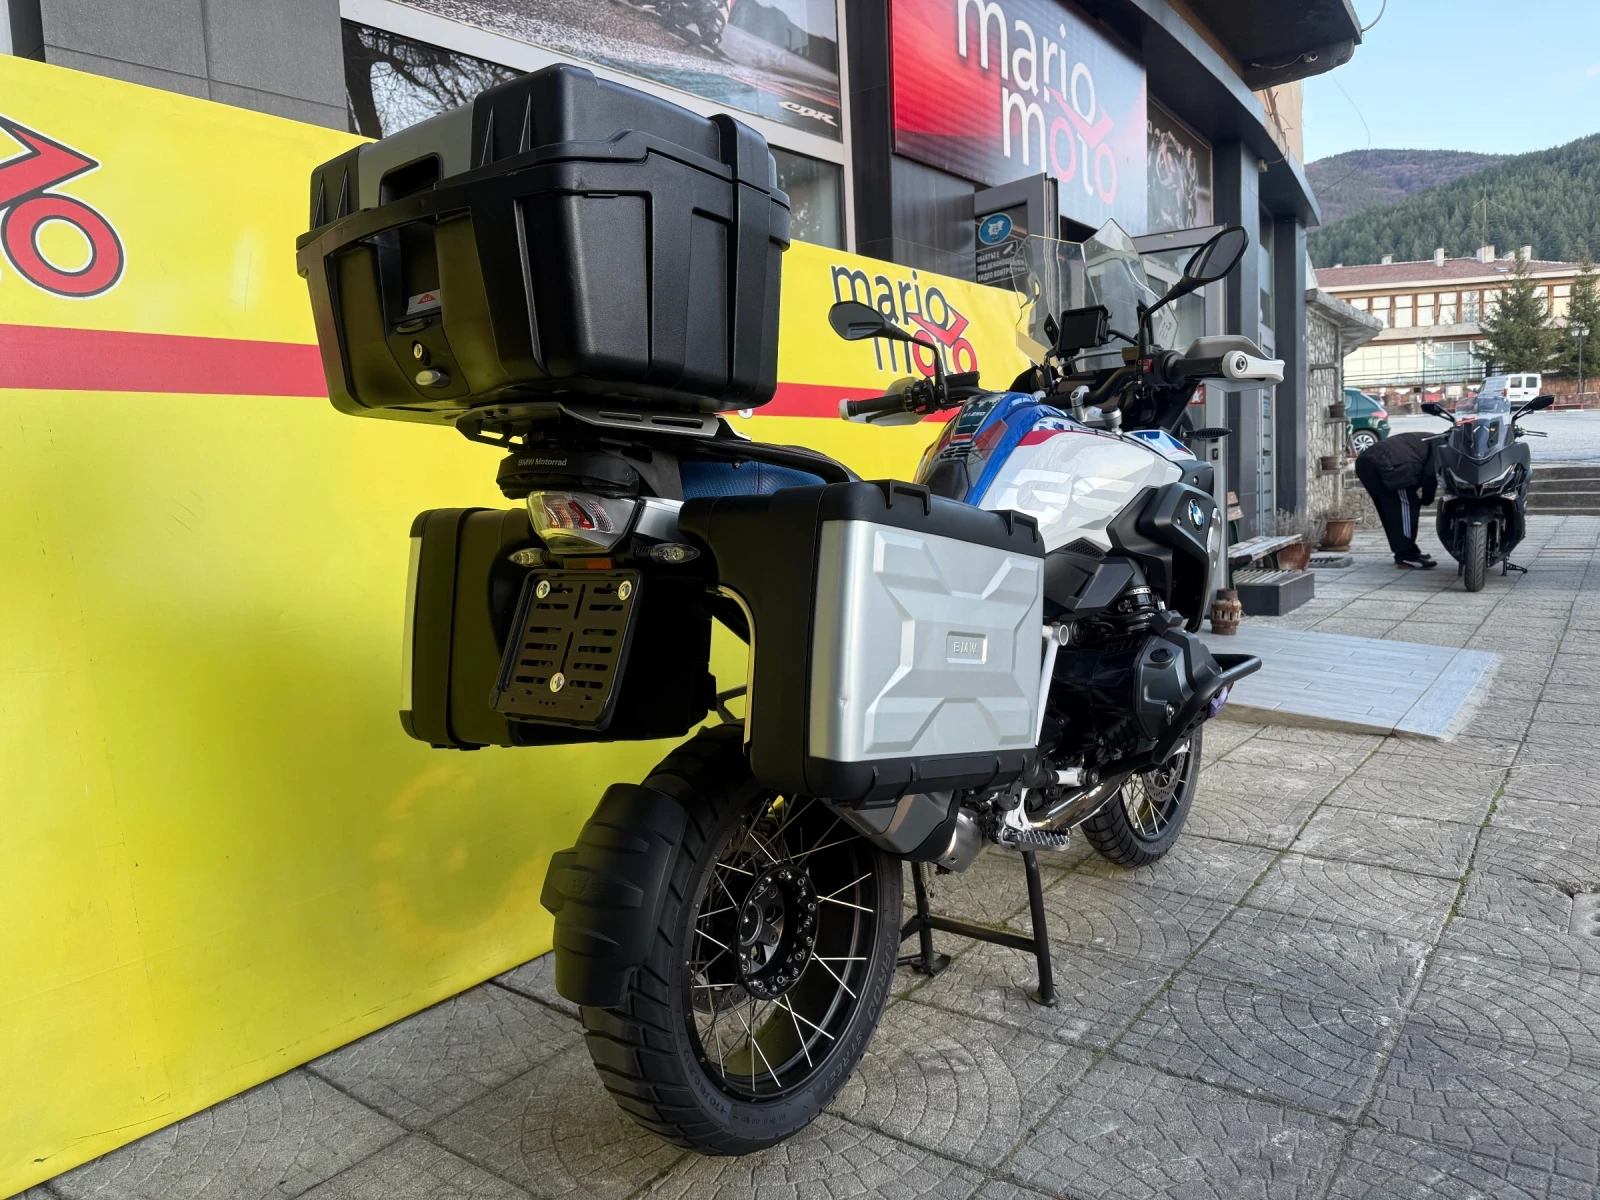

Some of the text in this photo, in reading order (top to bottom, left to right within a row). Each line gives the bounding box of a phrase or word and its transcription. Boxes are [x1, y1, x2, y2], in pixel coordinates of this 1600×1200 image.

[957, 0, 1096, 125] mario
[1001, 87, 1117, 205] moto
[831, 265, 949, 331] mario
[518, 458, 568, 467] BMW Motorrad
[953, 641, 977, 654] BMW
